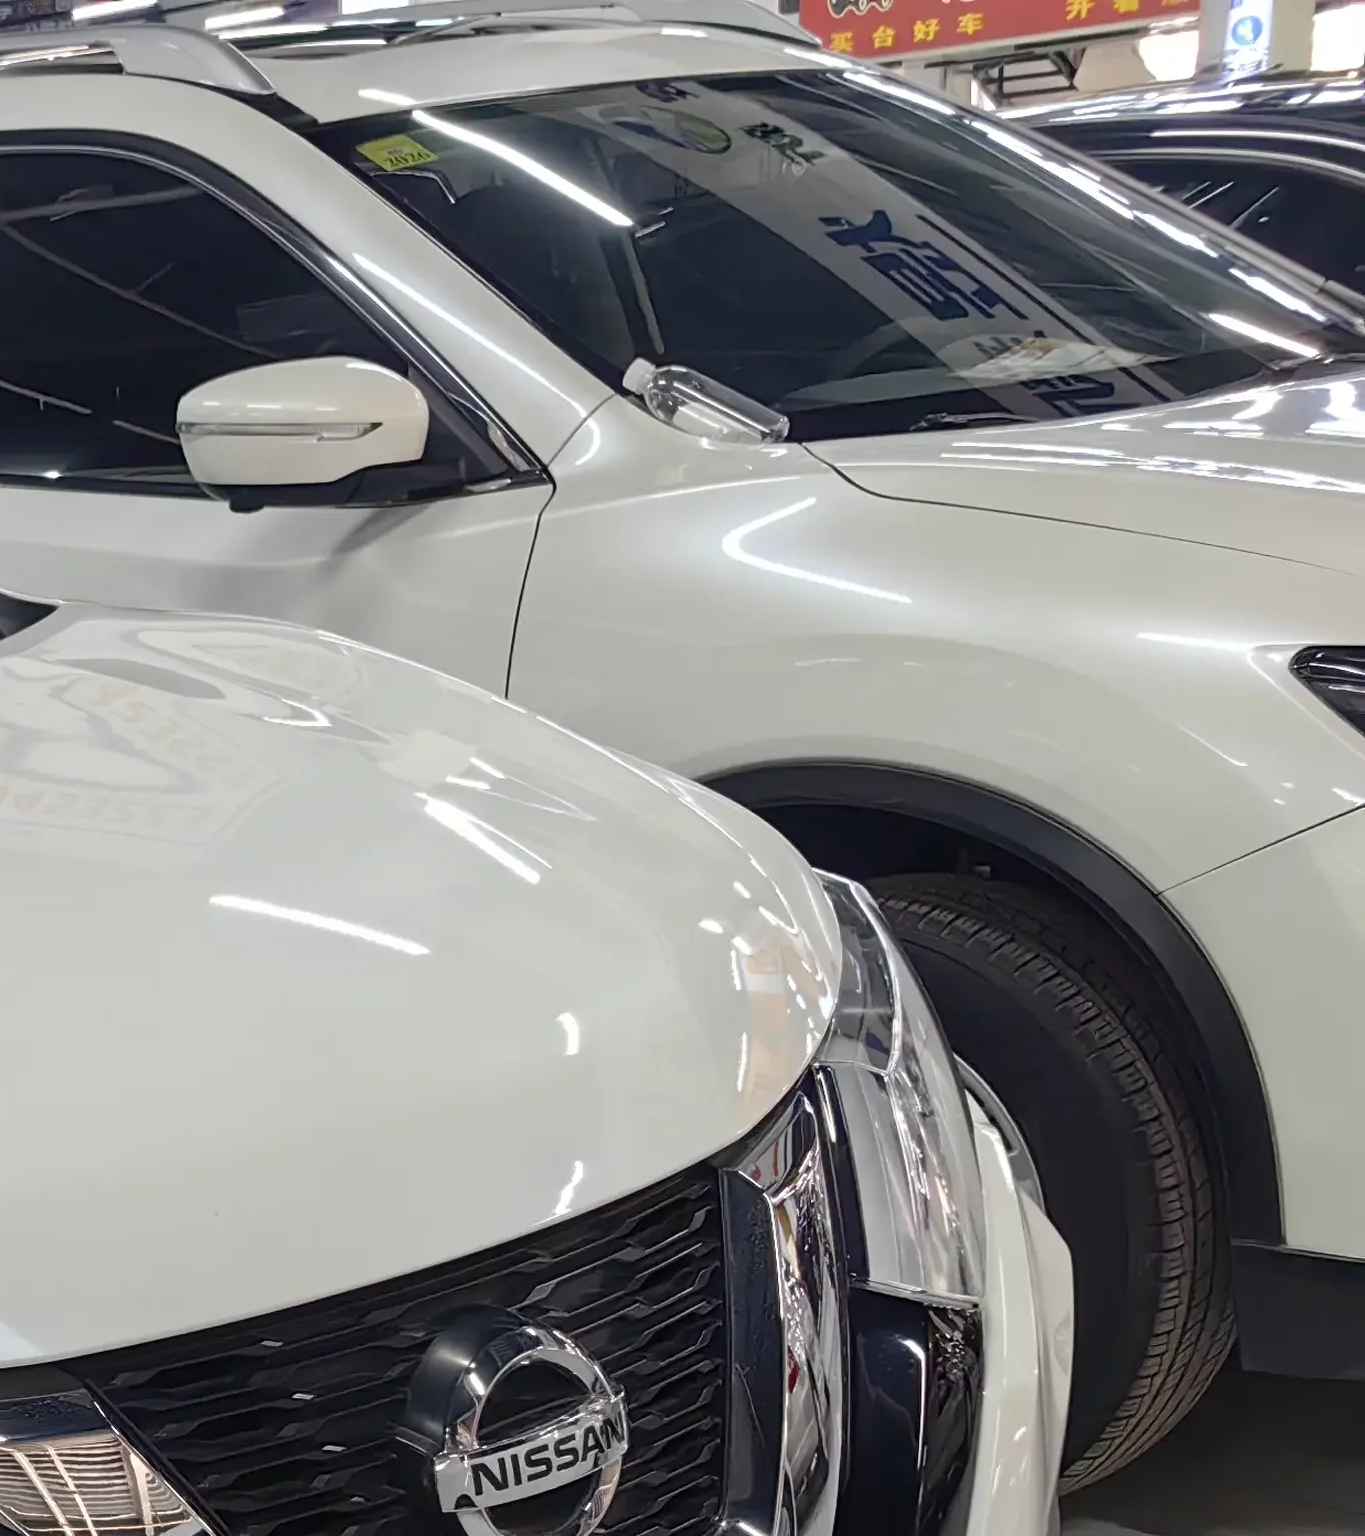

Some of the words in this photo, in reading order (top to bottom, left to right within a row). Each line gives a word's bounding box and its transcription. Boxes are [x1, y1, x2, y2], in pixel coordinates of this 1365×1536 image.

[829, 13, 984, 52] 买台好车
[470, 1411, 625, 1496] NISSAN
